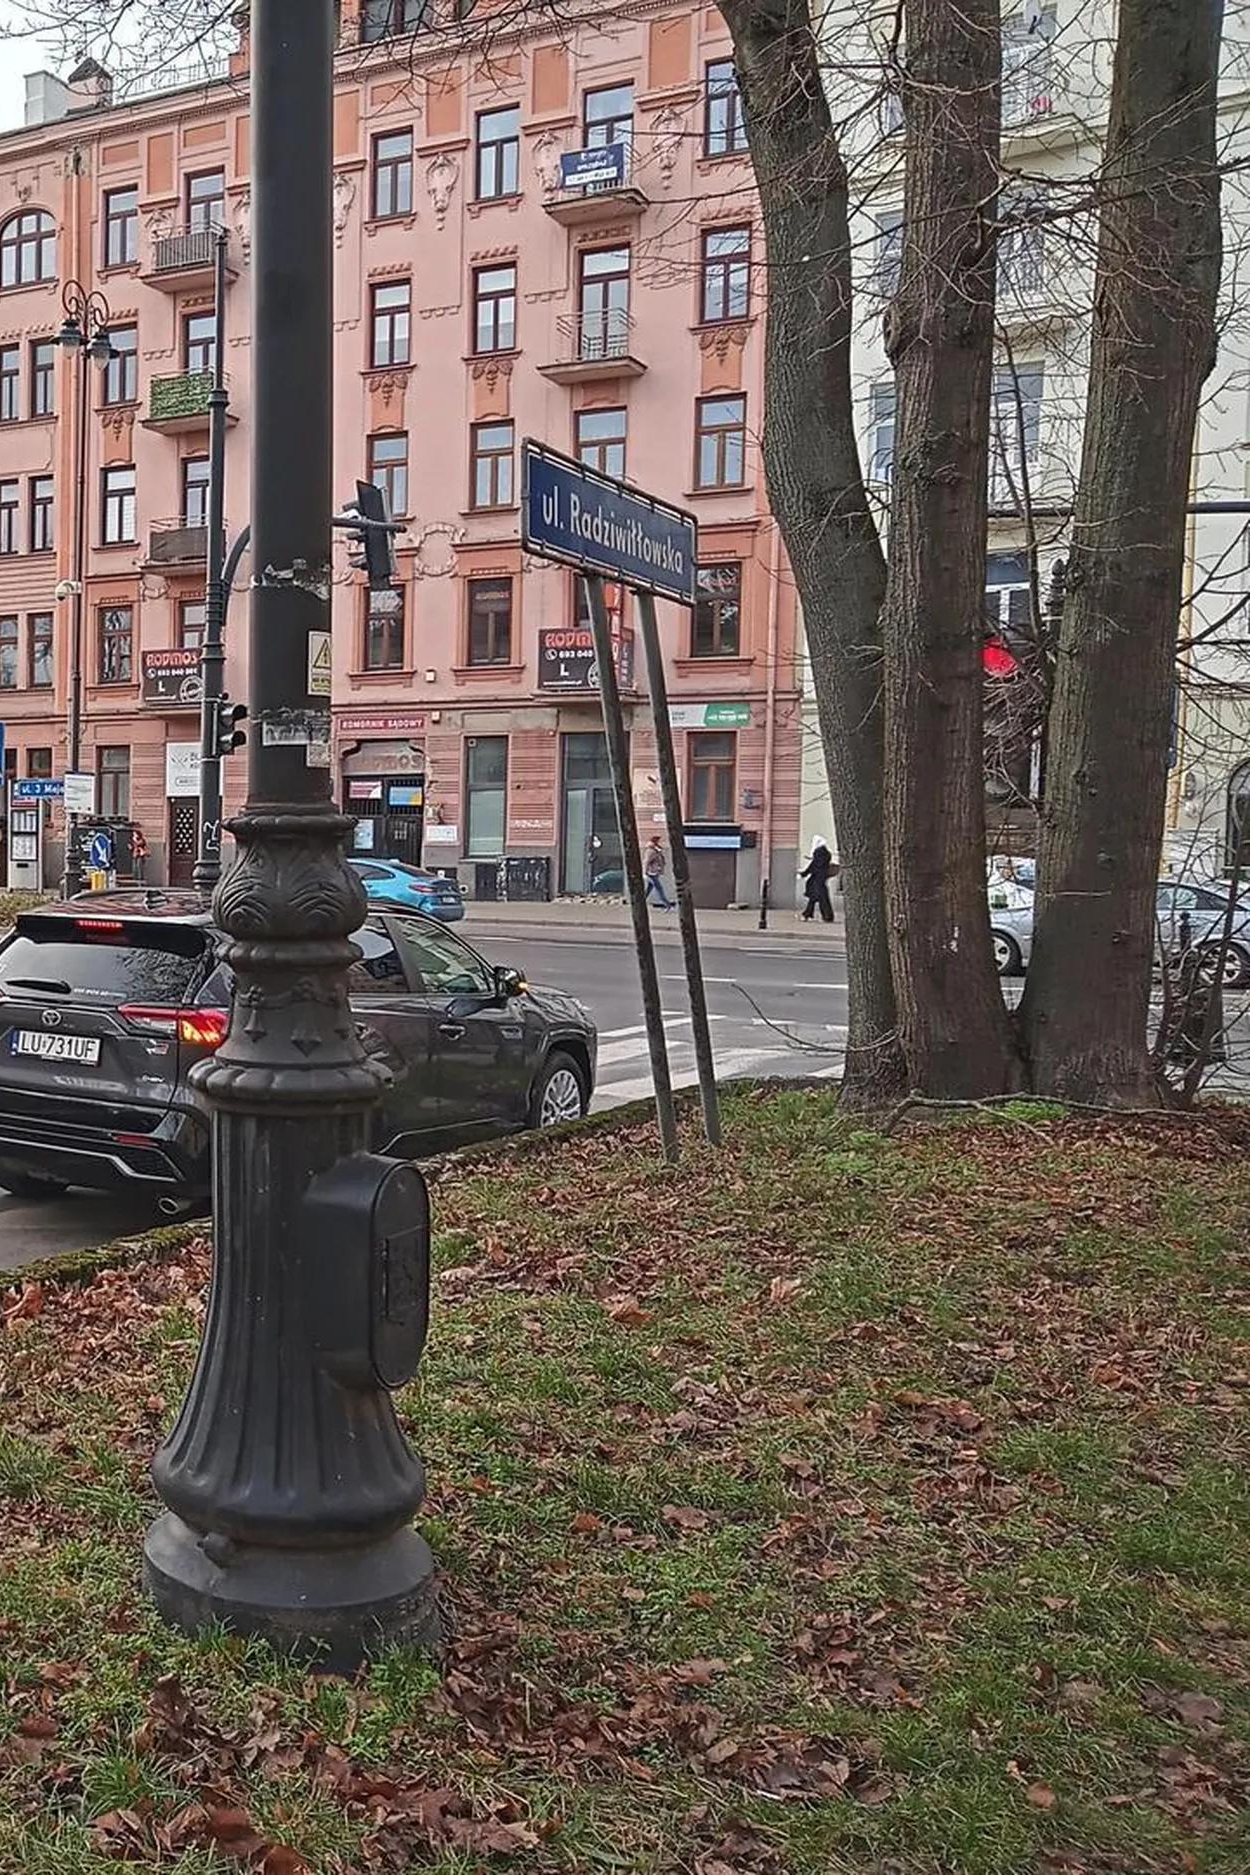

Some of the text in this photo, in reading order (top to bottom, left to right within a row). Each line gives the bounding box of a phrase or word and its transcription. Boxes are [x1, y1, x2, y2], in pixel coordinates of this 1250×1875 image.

[542, 485, 683, 575] ul. Radziwiłłowska
[545, 632, 592, 648] RODM
[560, 663, 569, 676] L
[158, 681, 166, 692] L
[35, 784, 41, 794] 3
[21, 1032, 96, 1059] LU 731UF
